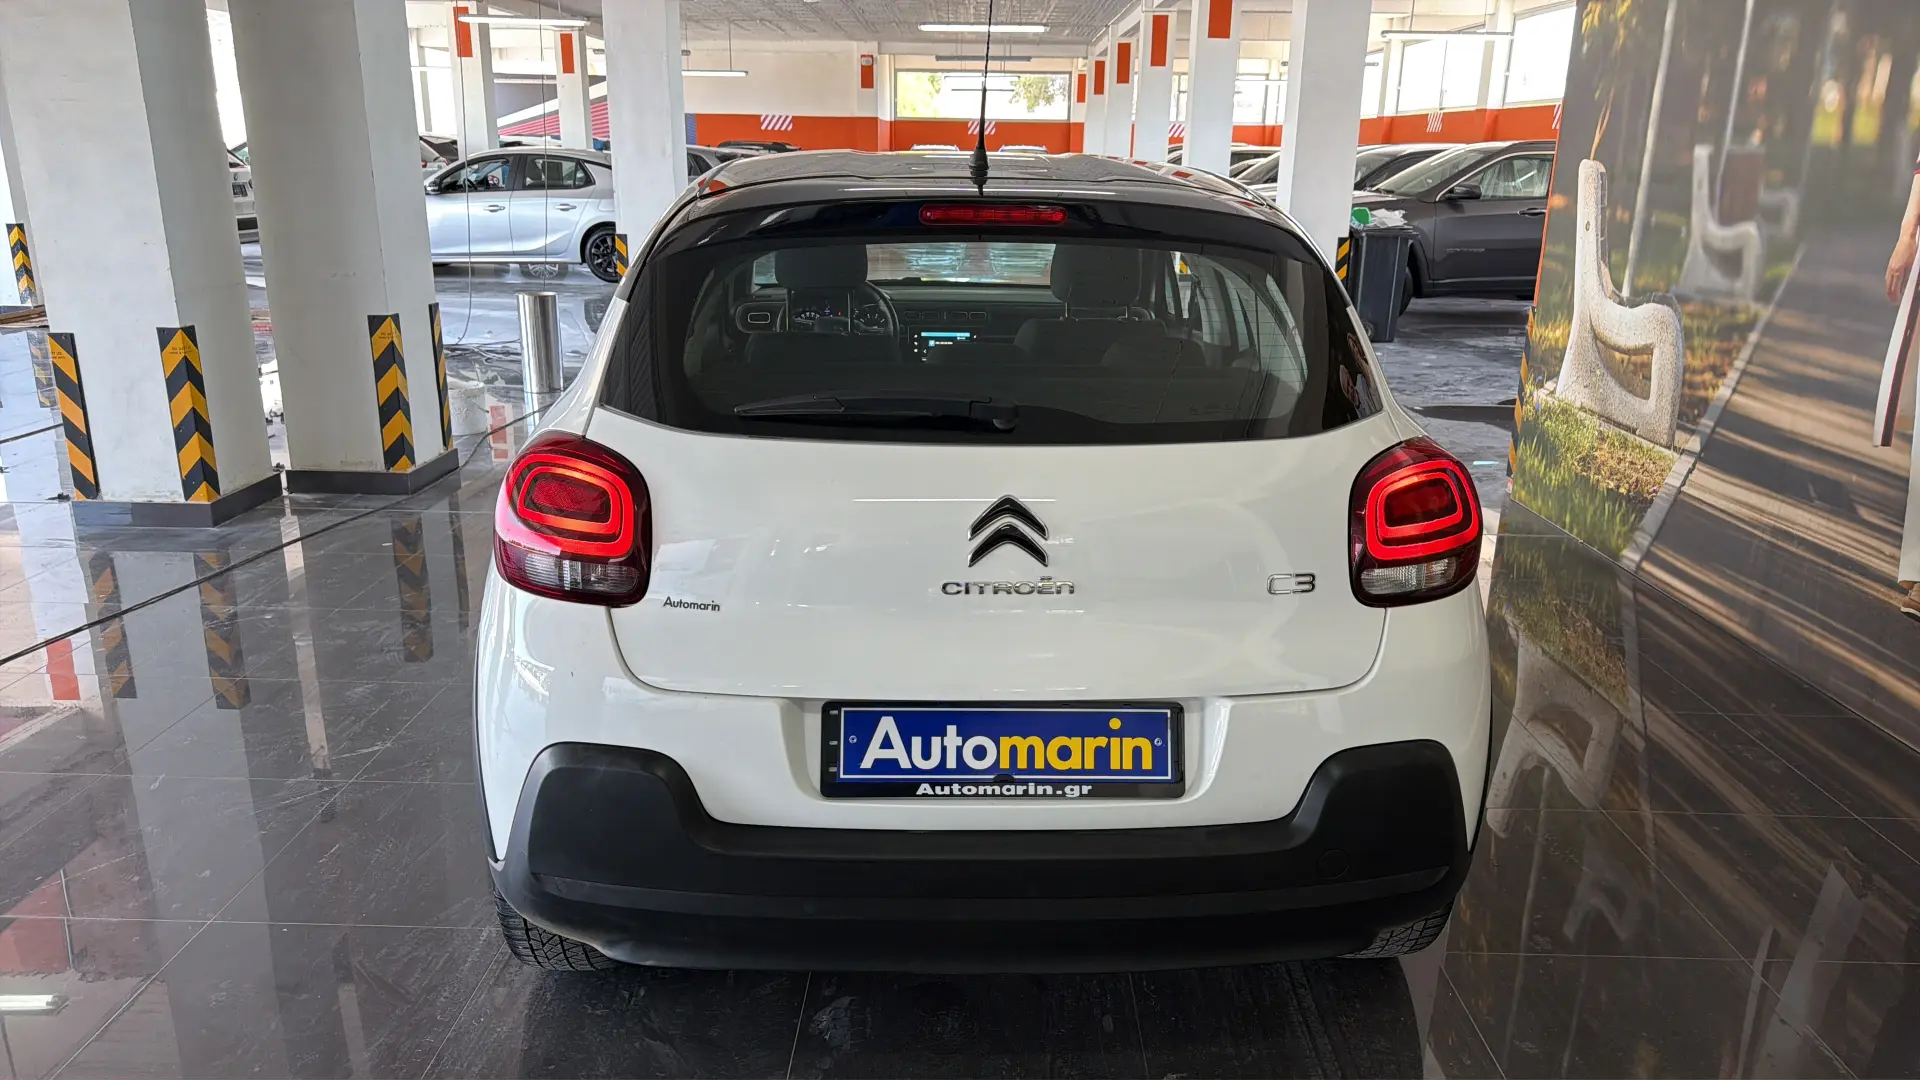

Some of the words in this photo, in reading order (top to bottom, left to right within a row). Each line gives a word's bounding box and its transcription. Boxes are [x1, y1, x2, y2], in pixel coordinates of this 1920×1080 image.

[1267, 573, 1316, 595] C3
[663, 596, 720, 611] Automarin
[859, 716, 1153, 770] Automarin
[916, 782, 1092, 797] Automarin.gr
